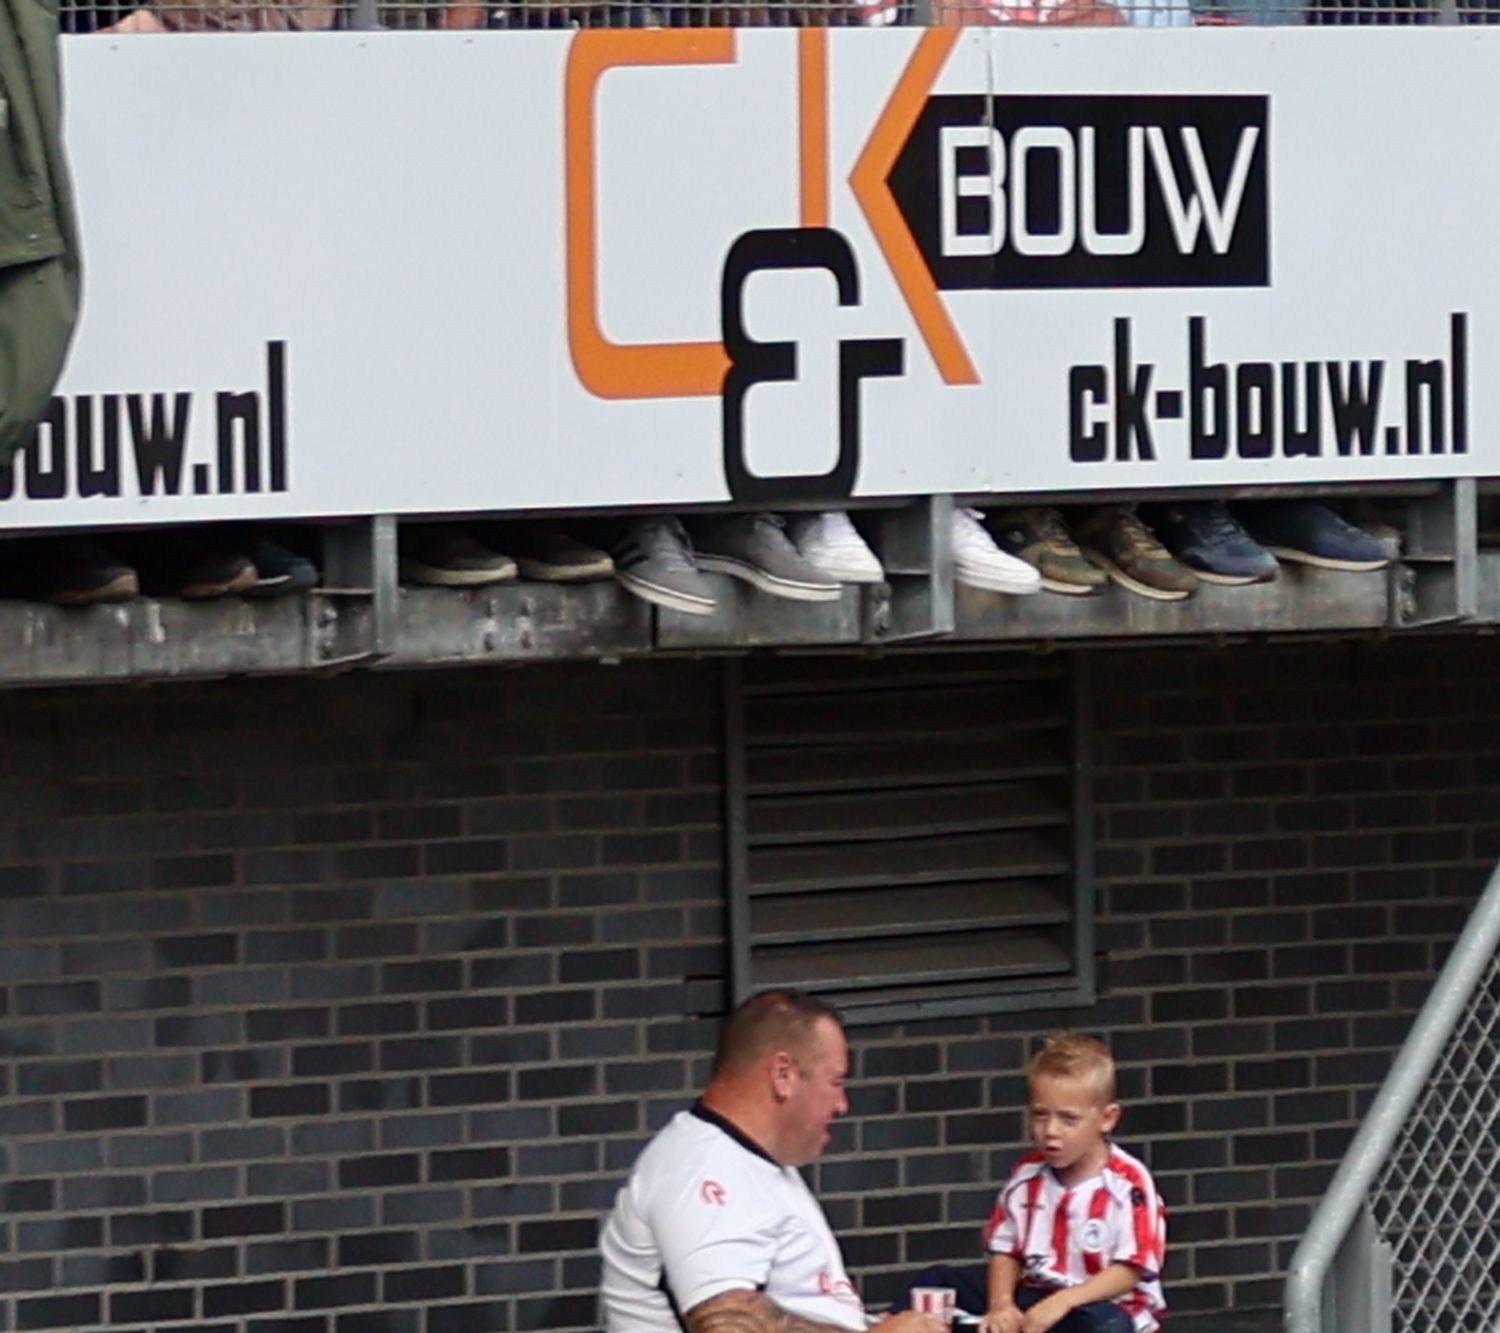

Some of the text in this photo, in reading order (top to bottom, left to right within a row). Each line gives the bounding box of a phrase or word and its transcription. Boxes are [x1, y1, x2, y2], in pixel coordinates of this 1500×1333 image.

[939, 126, 1260, 257] BOUW
[720, 227, 905, 500] &
[1069, 312, 1468, 462] ck-bouw.nl
